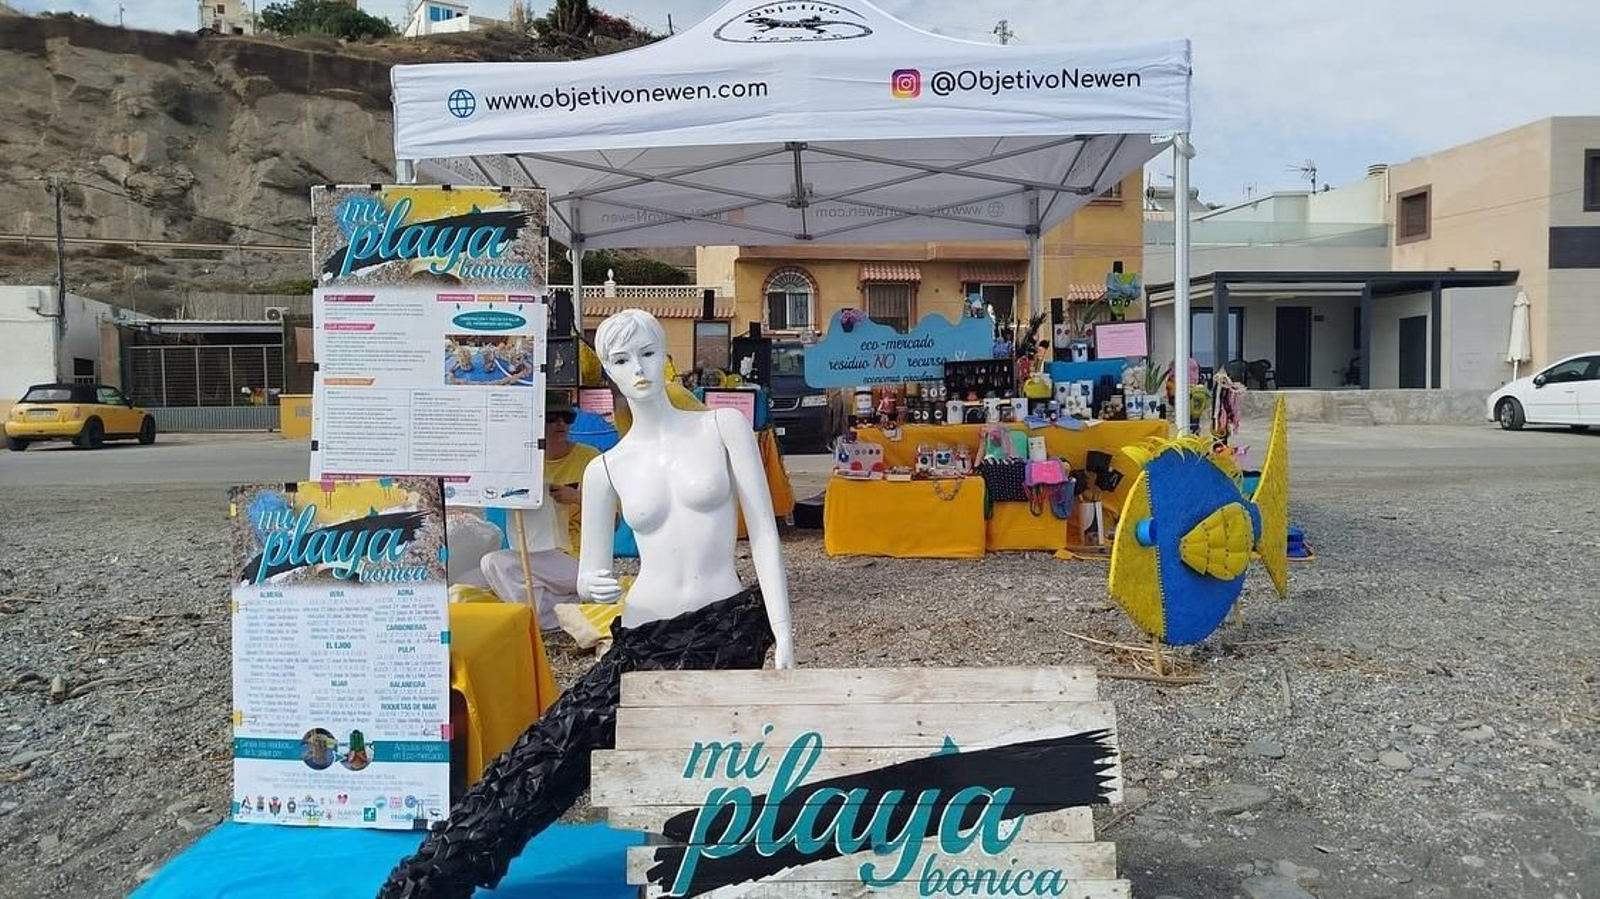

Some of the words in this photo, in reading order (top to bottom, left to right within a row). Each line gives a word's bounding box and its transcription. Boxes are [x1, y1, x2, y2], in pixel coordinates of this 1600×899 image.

[747, 4, 840, 18] Objetivo
[485, 80, 768, 112] www.objetivonewen.com
[931, 68, 1142, 97] @ObjetivoNewen
[340, 197, 510, 278] playa
[457, 258, 533, 280] bonica
[860, 333, 935, 352] eco-mercado
[829, 354, 871, 371] residuo
[873, 353, 896, 369] NO
[255, 503, 409, 584] playa
[358, 560, 429, 583] bonica
[682, 723, 775, 780] mi
[667, 730, 1026, 898] playa
[918, 852, 1069, 898] bonica
